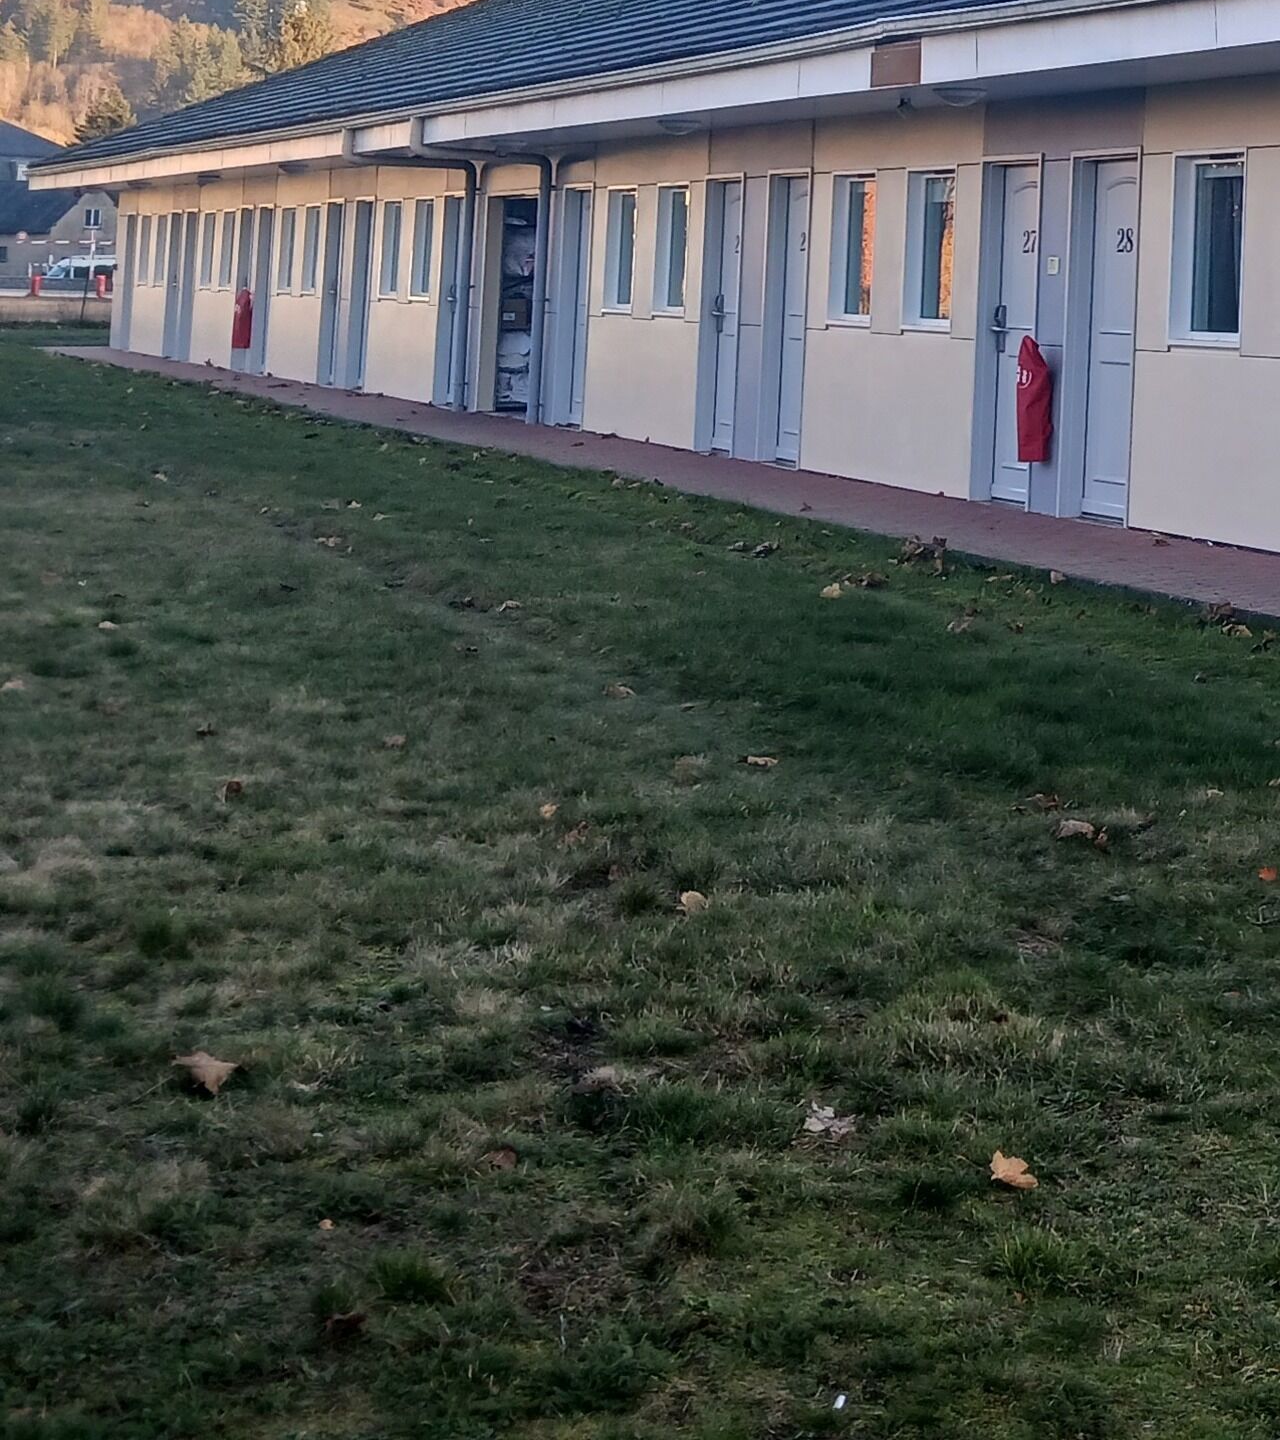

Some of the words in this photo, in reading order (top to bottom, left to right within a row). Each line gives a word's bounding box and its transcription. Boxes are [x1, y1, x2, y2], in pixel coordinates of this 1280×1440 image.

[800, 232, 807, 252] 2
[1022, 230, 1037, 254] 27
[1116, 228, 1134, 253] 28
